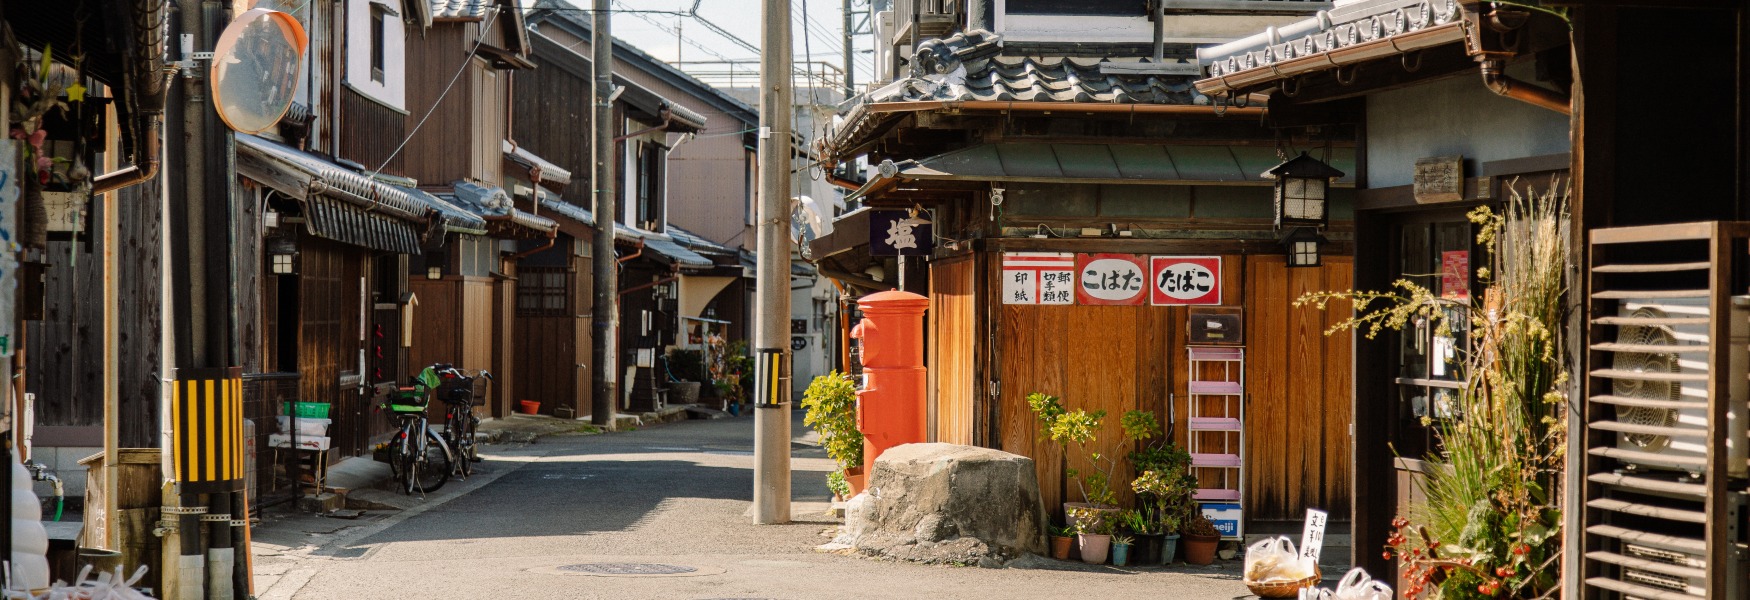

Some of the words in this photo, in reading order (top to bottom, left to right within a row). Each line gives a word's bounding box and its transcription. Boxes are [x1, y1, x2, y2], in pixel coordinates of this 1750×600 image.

[1014, 272, 1029, 302] 印紙
[1159, 268, 1210, 293] たばこ
